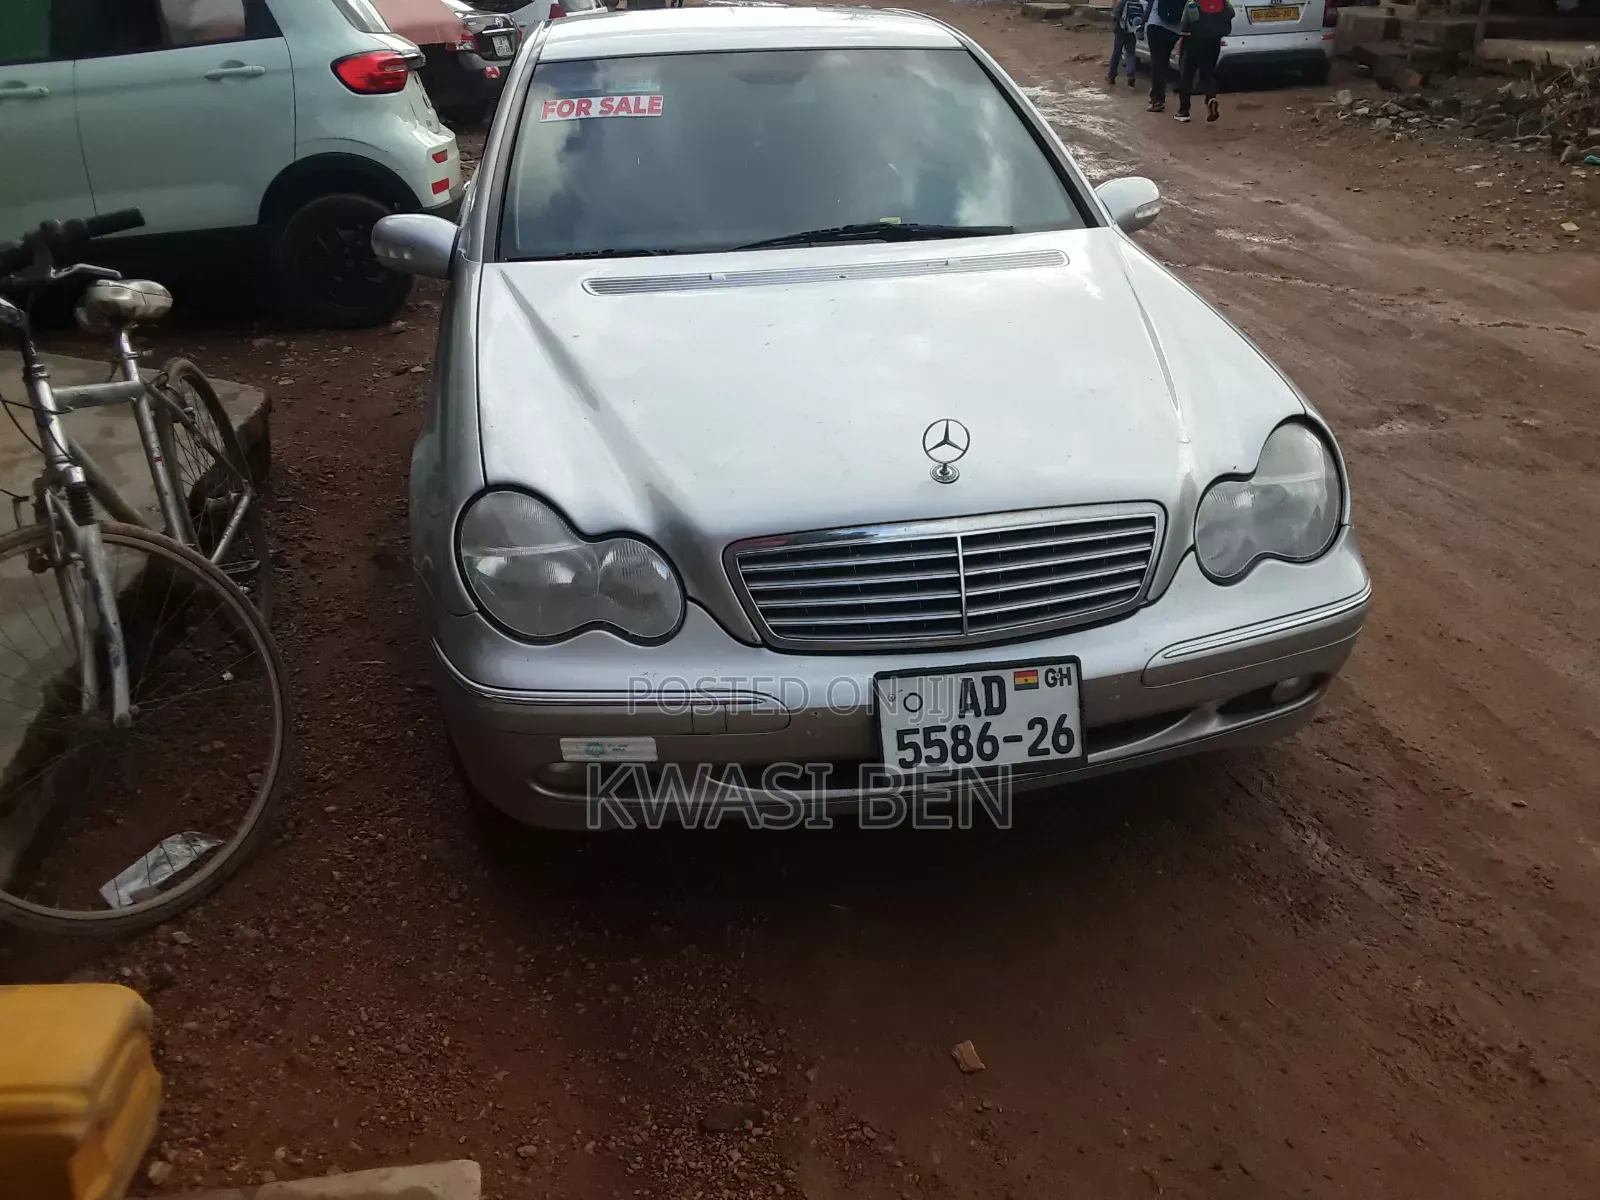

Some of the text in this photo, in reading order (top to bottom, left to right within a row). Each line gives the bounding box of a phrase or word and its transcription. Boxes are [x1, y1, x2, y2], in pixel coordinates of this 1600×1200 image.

[541, 96, 663, 120] FOR SALE
[1044, 666, 1072, 688] GH
[958, 675, 1007, 719] AD
[896, 713, 1075, 770] 5586-26
